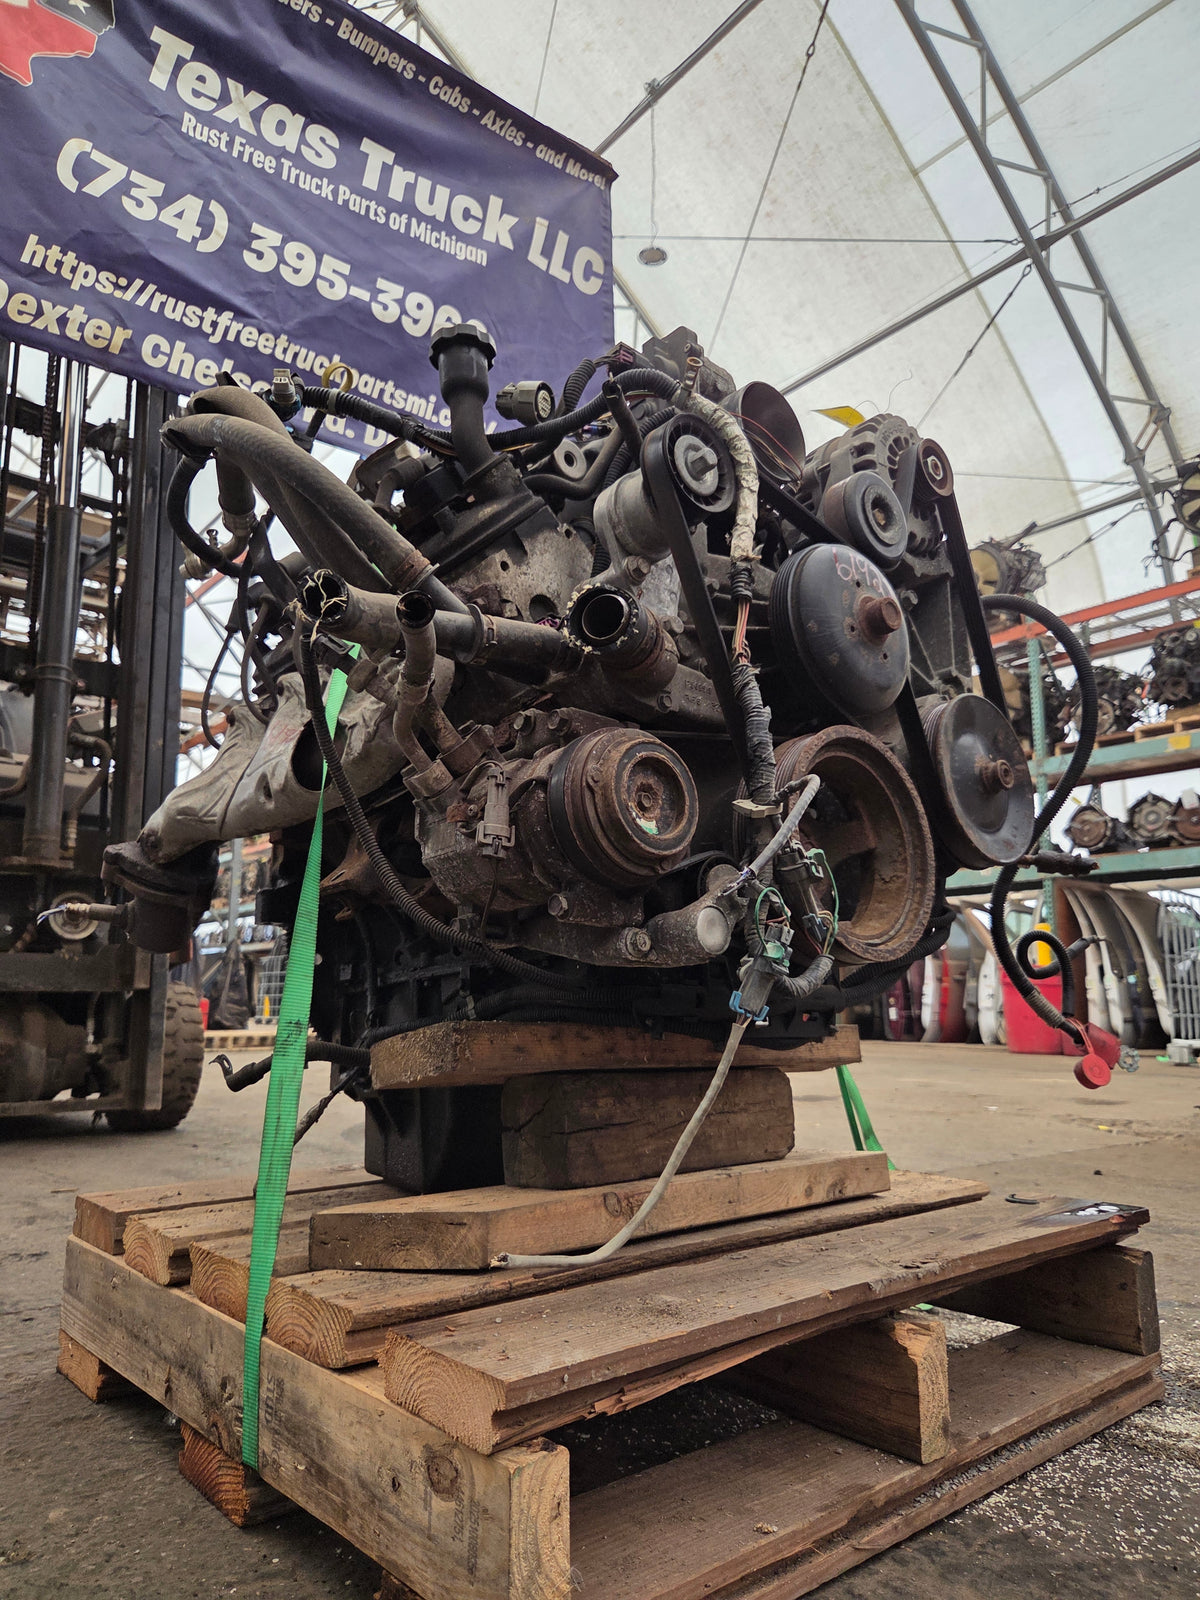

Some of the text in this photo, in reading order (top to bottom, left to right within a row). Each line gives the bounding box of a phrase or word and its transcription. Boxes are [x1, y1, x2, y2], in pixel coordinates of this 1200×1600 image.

[149, 25, 605, 295] Texas Truck LLC
[337, 18, 417, 80] Bumpers
[428, 75, 472, 113] Cabs
[480, 109, 526, 147] Axles
[535, 144, 568, 170] and
[56, 137, 229, 253] (734)
[181, 111, 488, 267] Rust Free Truck Parts of Michigan
[0, 278, 133, 355] exter
